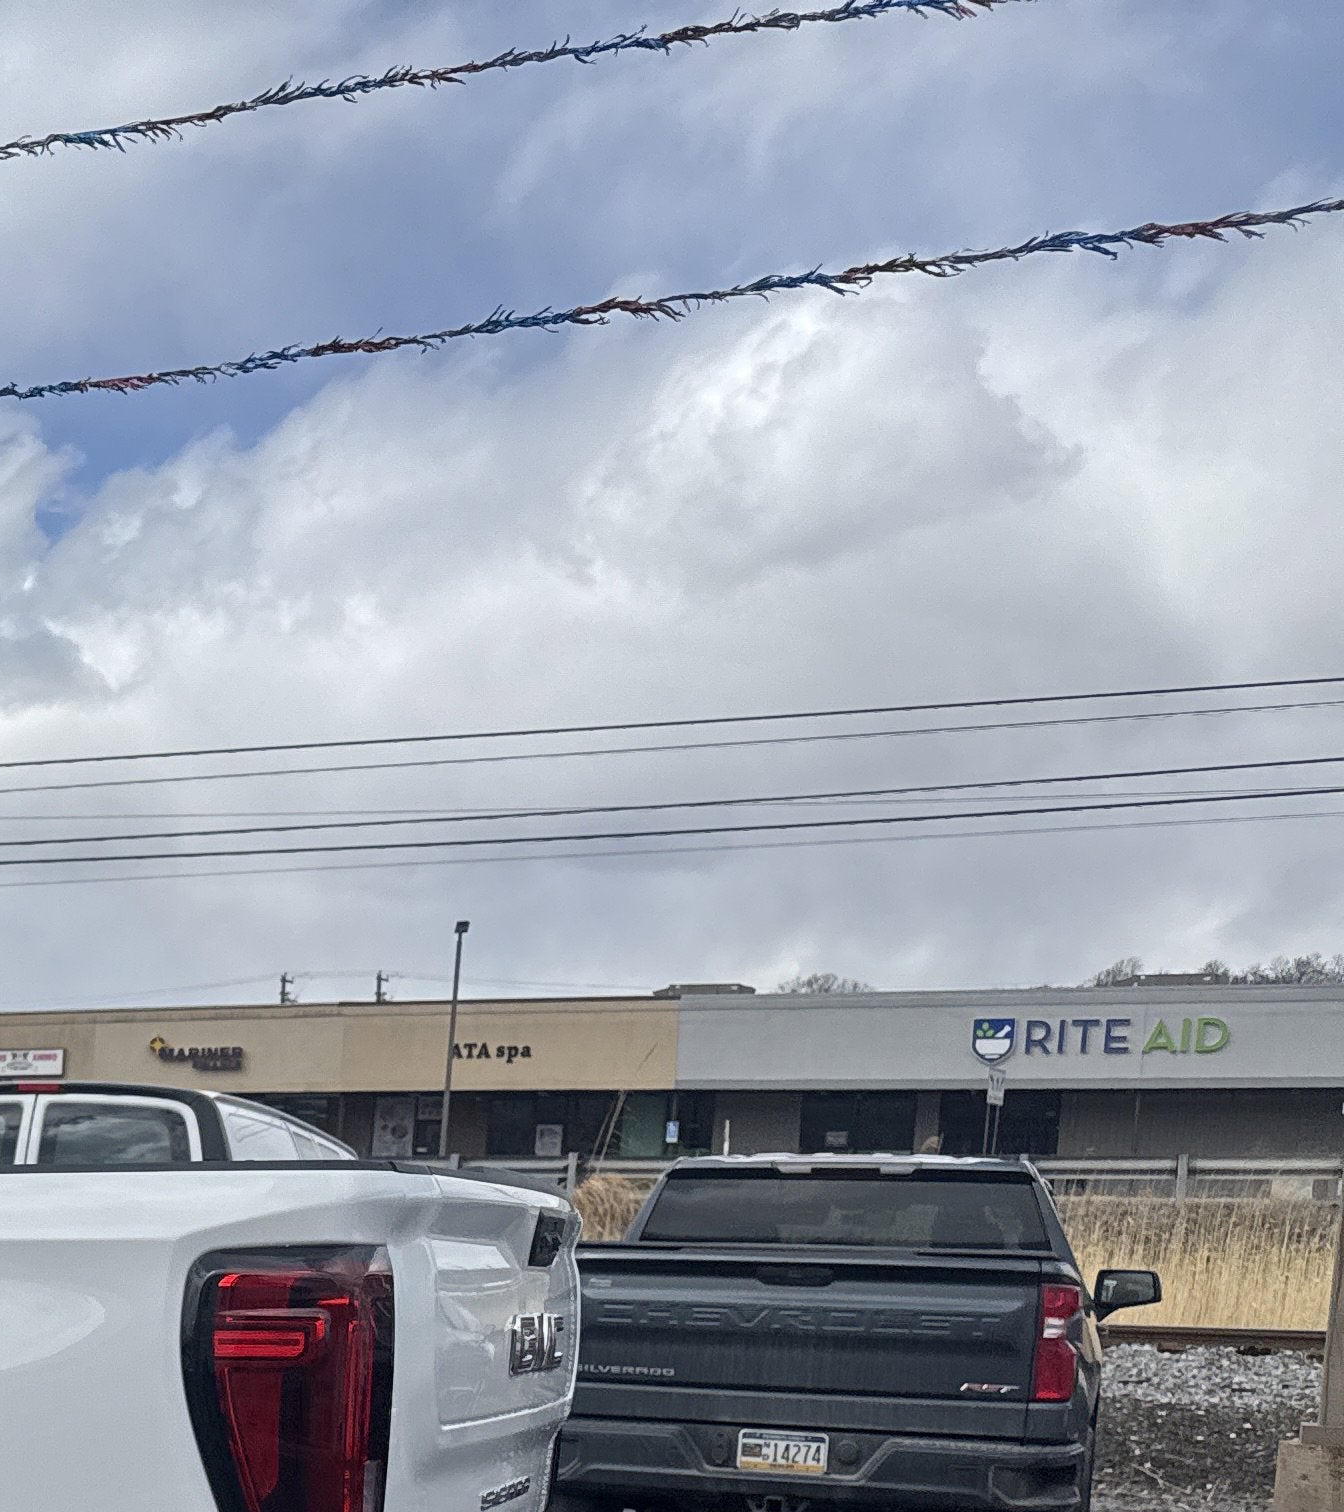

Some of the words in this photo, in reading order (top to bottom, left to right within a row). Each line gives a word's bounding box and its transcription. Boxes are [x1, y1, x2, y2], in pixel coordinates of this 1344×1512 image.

[1024, 1018, 1132, 1055] RITE
[1141, 1017, 1231, 1055] AID
[496, 1045, 531, 1064] spa
[596, 1302, 1002, 1337] CHEVROLET
[772, 1442, 822, 1465] 14274
